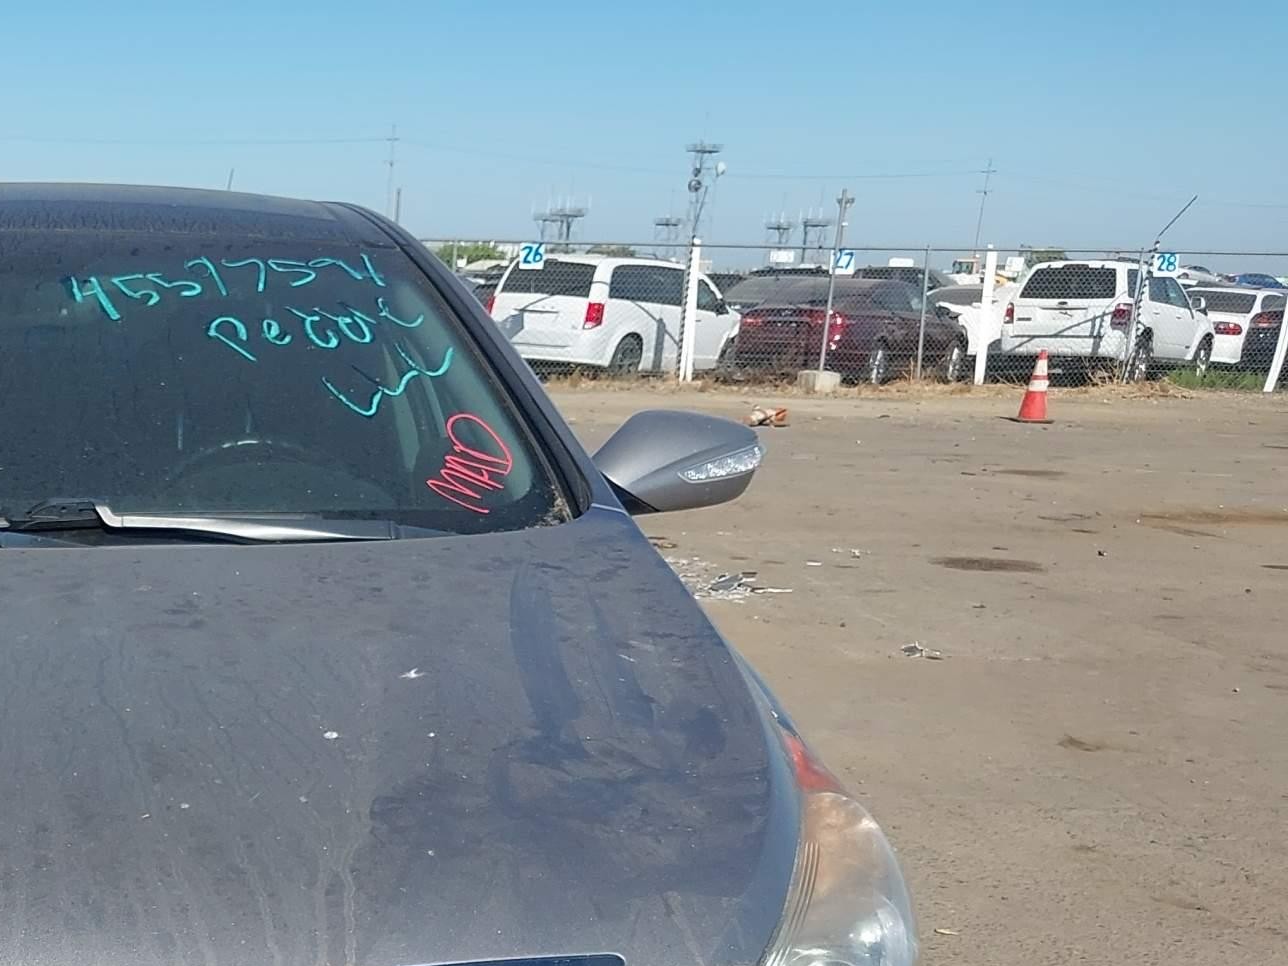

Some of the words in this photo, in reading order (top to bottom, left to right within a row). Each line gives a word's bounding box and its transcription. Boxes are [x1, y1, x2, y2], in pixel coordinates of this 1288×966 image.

[521, 243, 543, 264] 26
[833, 249, 854, 270] 27
[1157, 252, 1177, 272] 28
